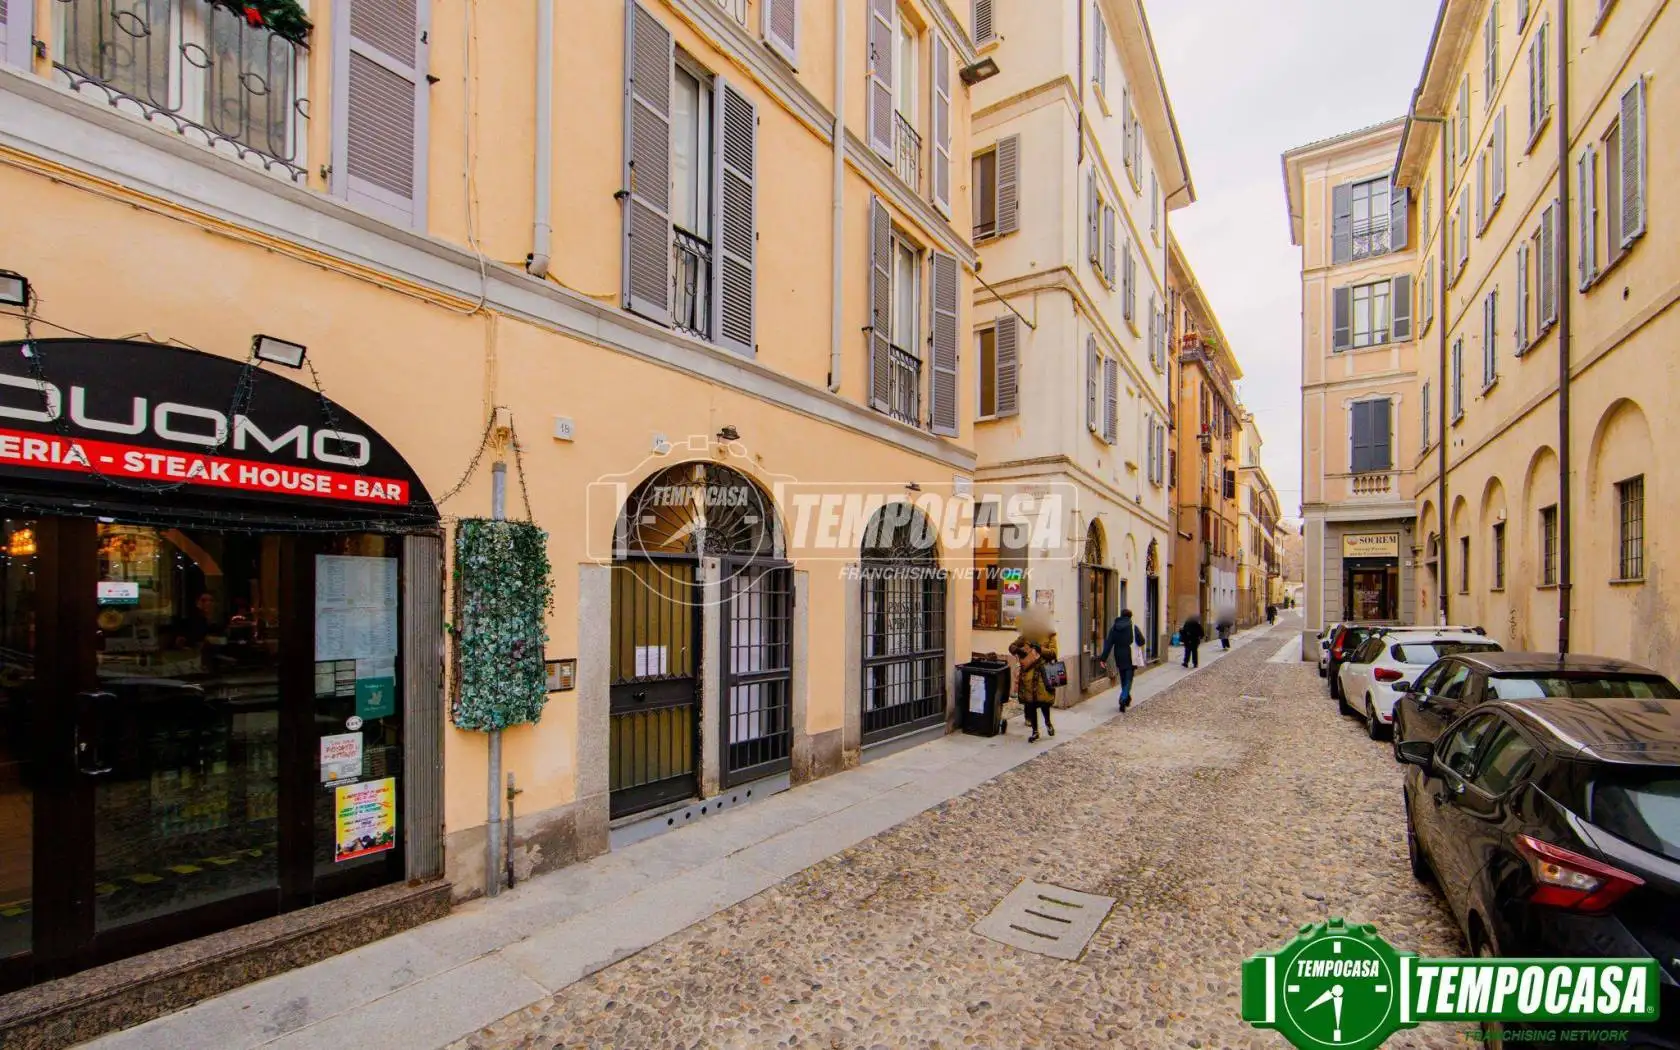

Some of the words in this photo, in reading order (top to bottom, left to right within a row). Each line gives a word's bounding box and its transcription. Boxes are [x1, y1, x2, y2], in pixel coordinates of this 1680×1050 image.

[123, 451, 231, 482] STEAK
[239, 464, 332, 494] HOUSE
[354, 480, 401, 501] BAR
[1359, 535, 1397, 544] SOCREM
